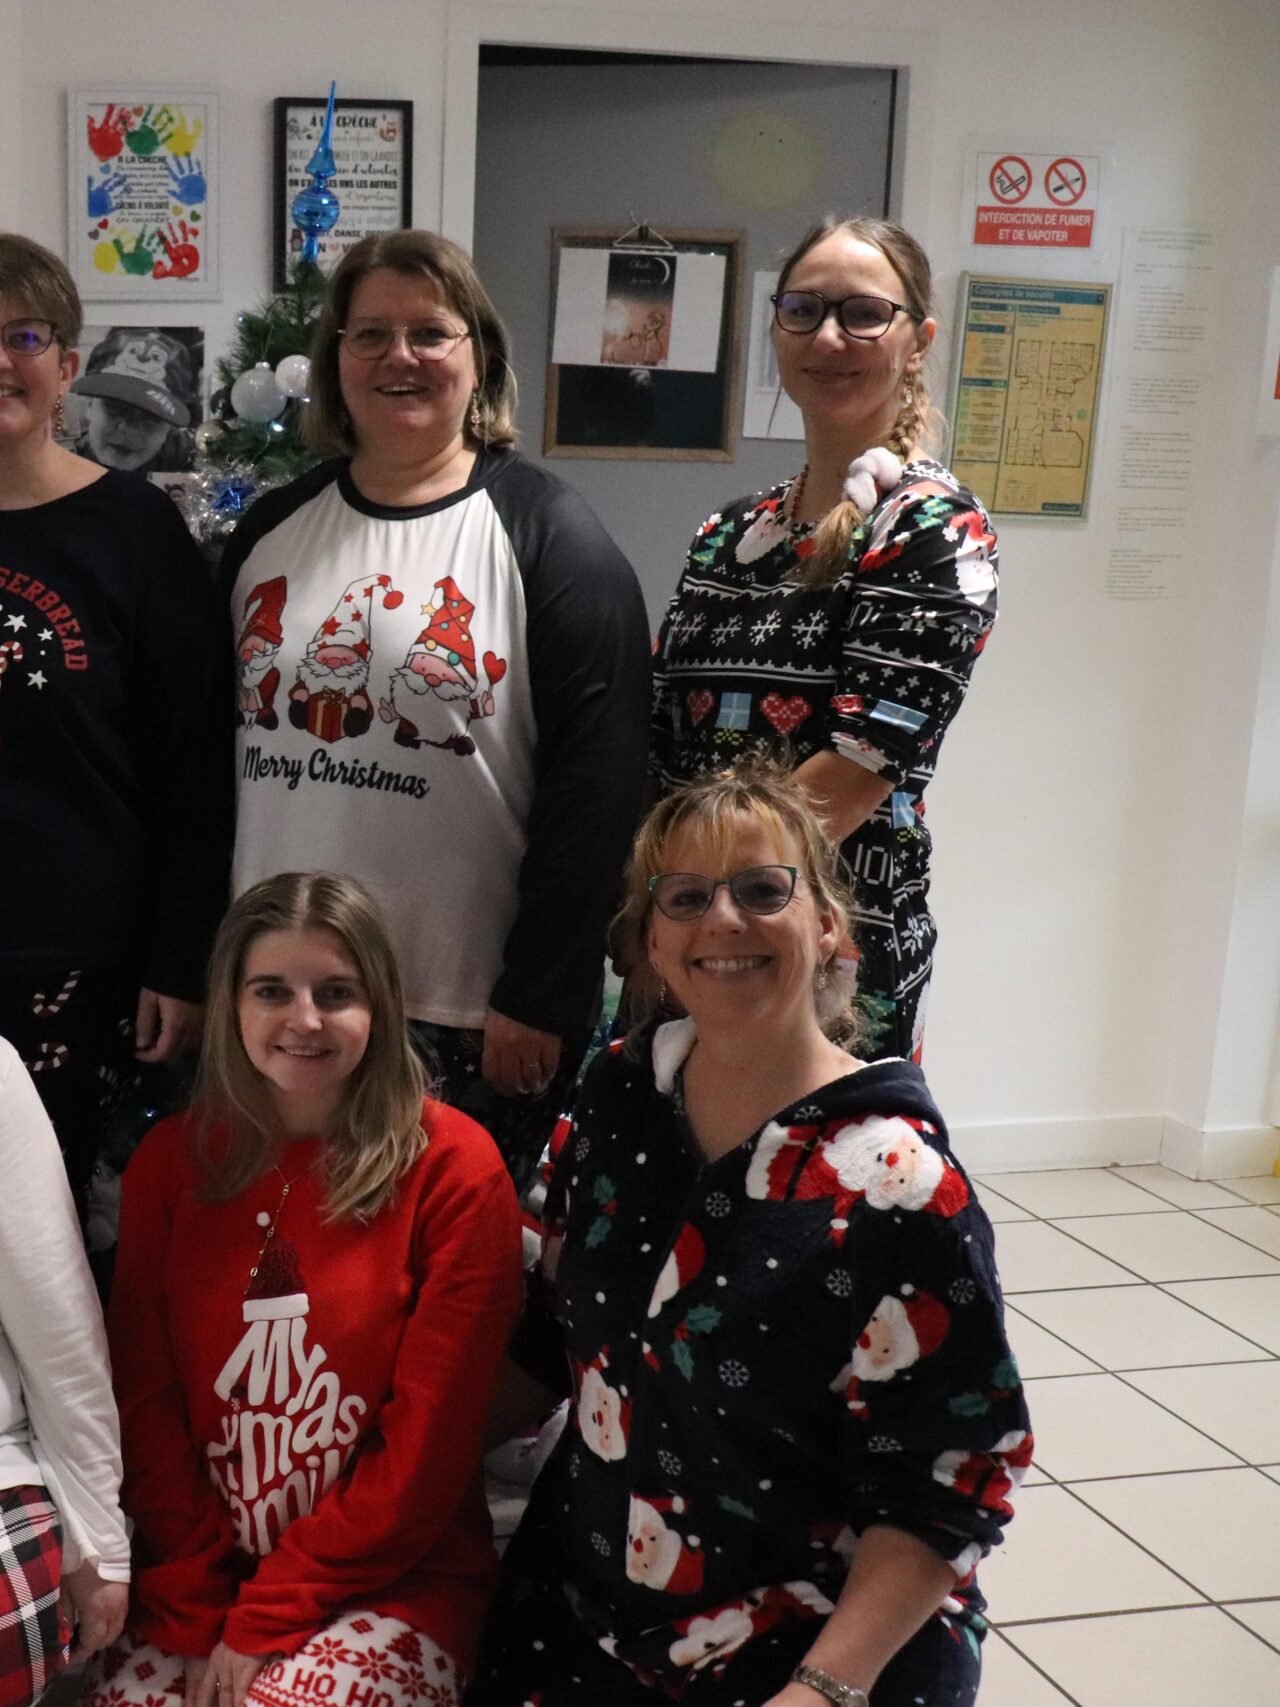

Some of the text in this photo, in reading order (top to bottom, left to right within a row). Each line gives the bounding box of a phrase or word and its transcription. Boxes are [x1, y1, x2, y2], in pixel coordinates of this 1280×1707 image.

[978, 212, 1091, 226] INTERDICTION DE FUMER
[998, 229, 1069, 242] ET DE VAPOTER
[243, 746, 431, 800] Merry Christmas
[213, 1316, 328, 1417] My
[291, 1667, 337, 1698] HO
